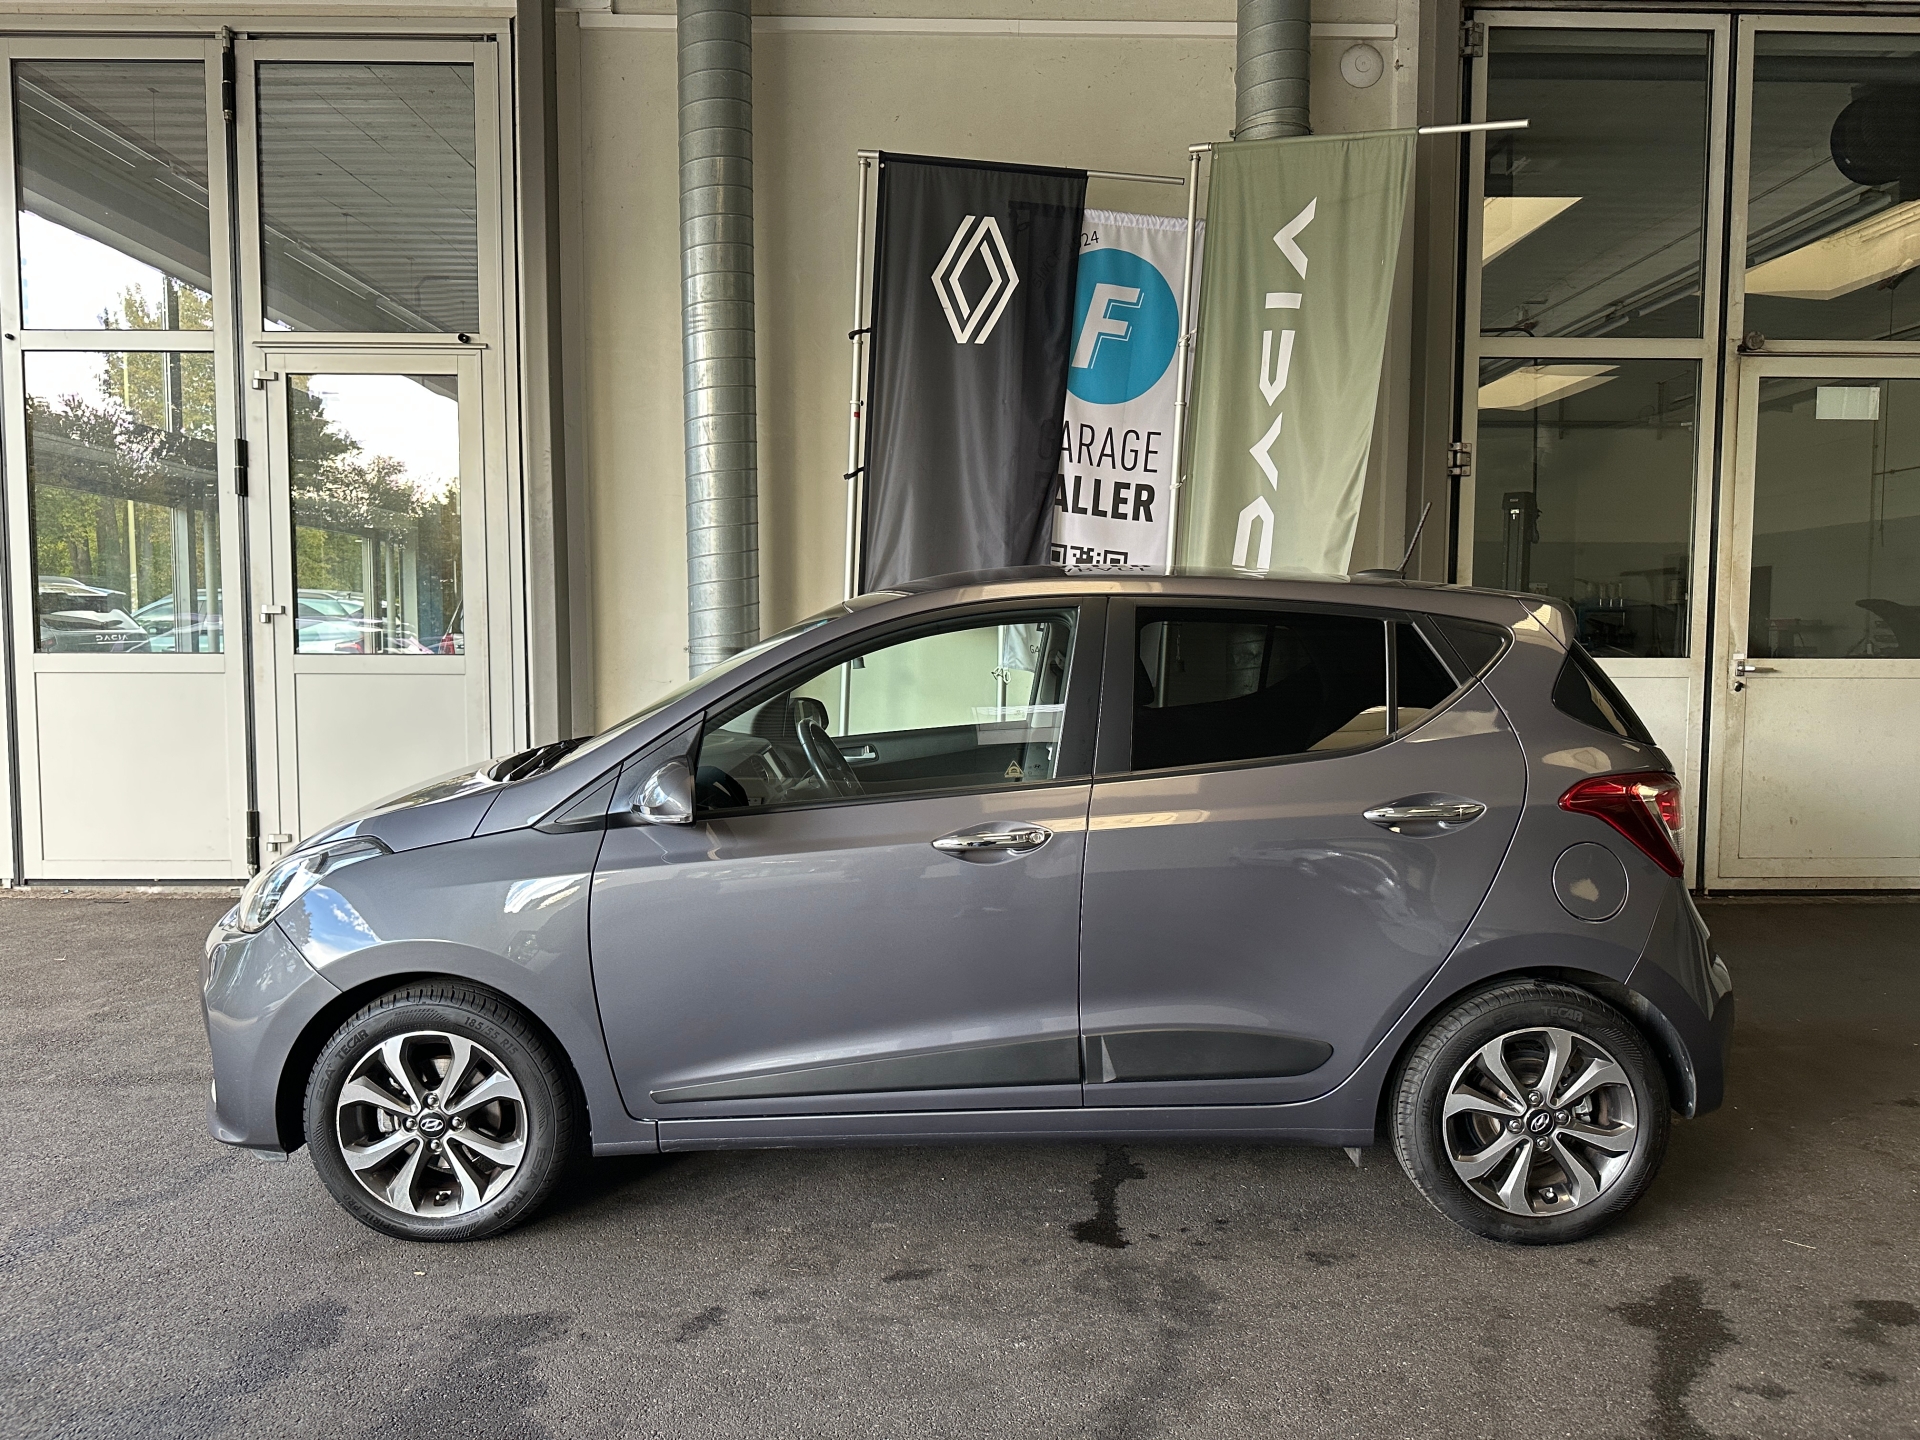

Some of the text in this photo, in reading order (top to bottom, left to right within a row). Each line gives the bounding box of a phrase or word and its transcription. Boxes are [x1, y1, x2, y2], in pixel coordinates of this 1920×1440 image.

[1071, 283, 1144, 369] F
[1232, 196, 1317, 570] DACIA
[1054, 473, 1156, 522] ALLER
[334, 1028, 370, 1061] TECAR
[464, 1016, 500, 1041] 185/55
